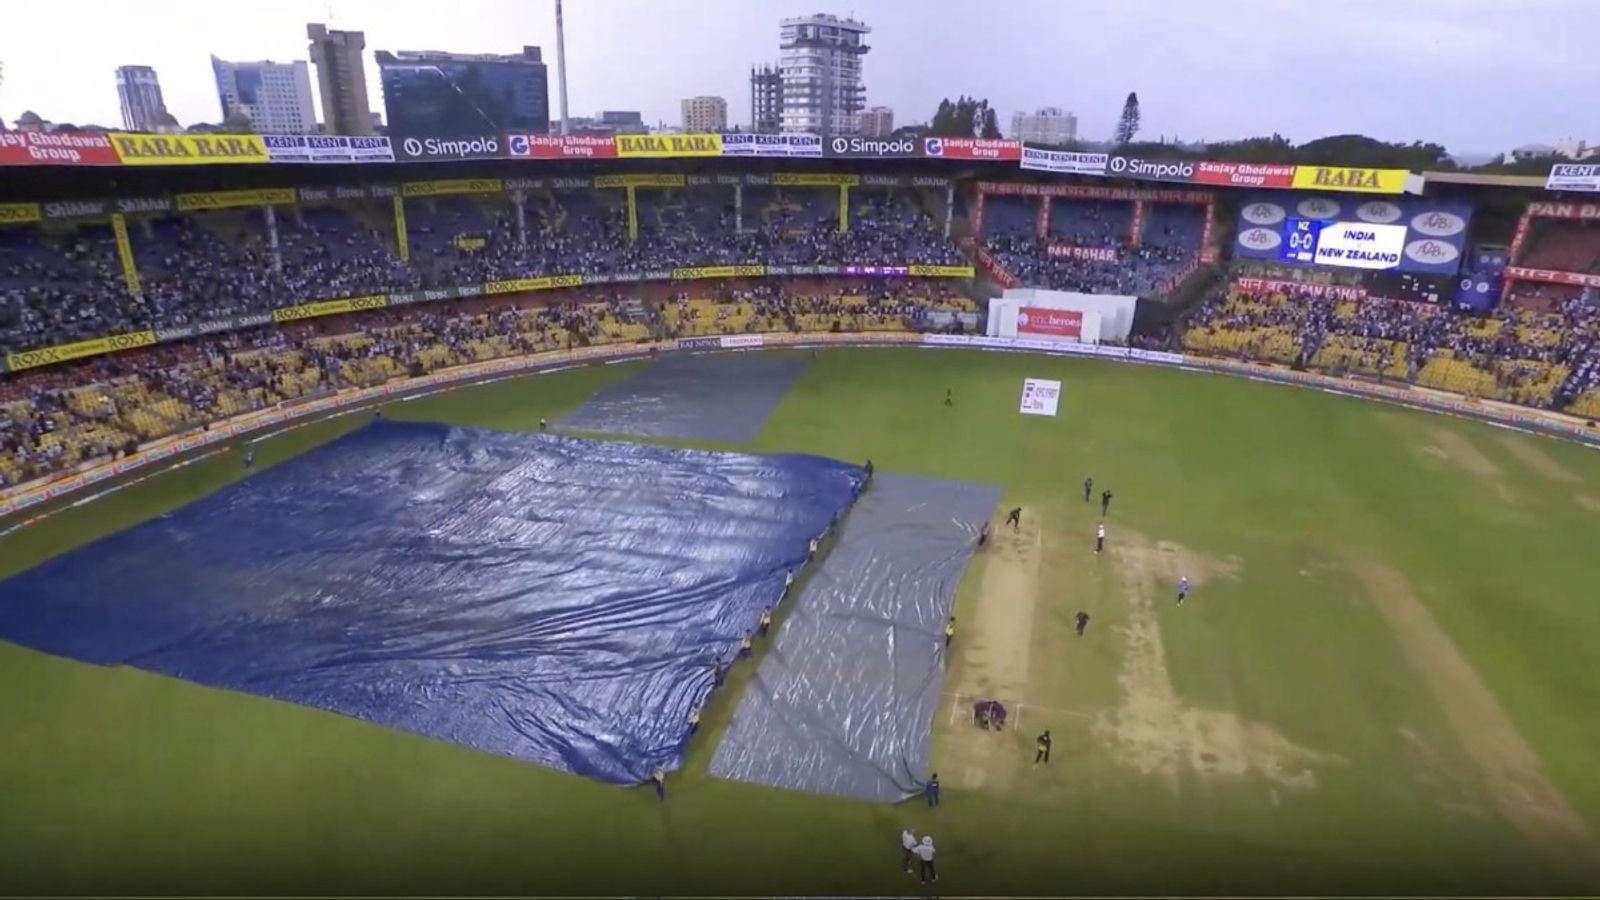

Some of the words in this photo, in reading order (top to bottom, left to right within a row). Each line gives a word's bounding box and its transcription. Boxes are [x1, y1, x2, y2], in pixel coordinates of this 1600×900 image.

[28, 132, 111, 147] Ghodawat
[269, 137, 298, 147] KENT
[312, 138, 340, 147] KENT
[354, 138, 382, 147] KENT
[529, 135, 564, 146] Sanjay
[566, 136, 614, 146] Ghodawat
[619, 138, 667, 151] BABA
[671, 138, 718, 151] BABA
[850, 138, 914, 154] Simpolo
[944, 138, 974, 147] Sanjay
[975, 139, 1020, 148] Ghodawat
[116, 138, 190, 157] BABA
[191, 138, 264, 156] BABA
[425, 137, 498, 156] Simpolo
[563, 146, 592, 155] Group
[972, 147, 999, 156] Group
[29, 146, 80, 161] Group
[1129, 159, 1193, 177] Simpolo
[1200, 162, 1236, 174] Sanjay
[1238, 163, 1294, 176] Ghodawat
[1560, 165, 1595, 177] KENT
[1231, 174, 1264, 185] Group
[1312, 168, 1381, 188] BABA
[1528, 203, 1572, 216] PAN
[1298, 222, 1310, 231] NZ
[1344, 230, 1376, 241] INDIA
[1048, 246, 1070, 257] PAN
[1318, 248, 1346, 259] NEW
[1346, 249, 1399, 262] ZEALAND
[487, 280, 519, 293] ROXX
[550, 275, 580, 287] ROXX
[349, 296, 384, 309] ROXX
[276, 307, 313, 321] ROXX
[199, 321, 233, 333] Shikhar
[108, 332, 151, 349] ROXX
[11, 350, 61, 368] ROXX
